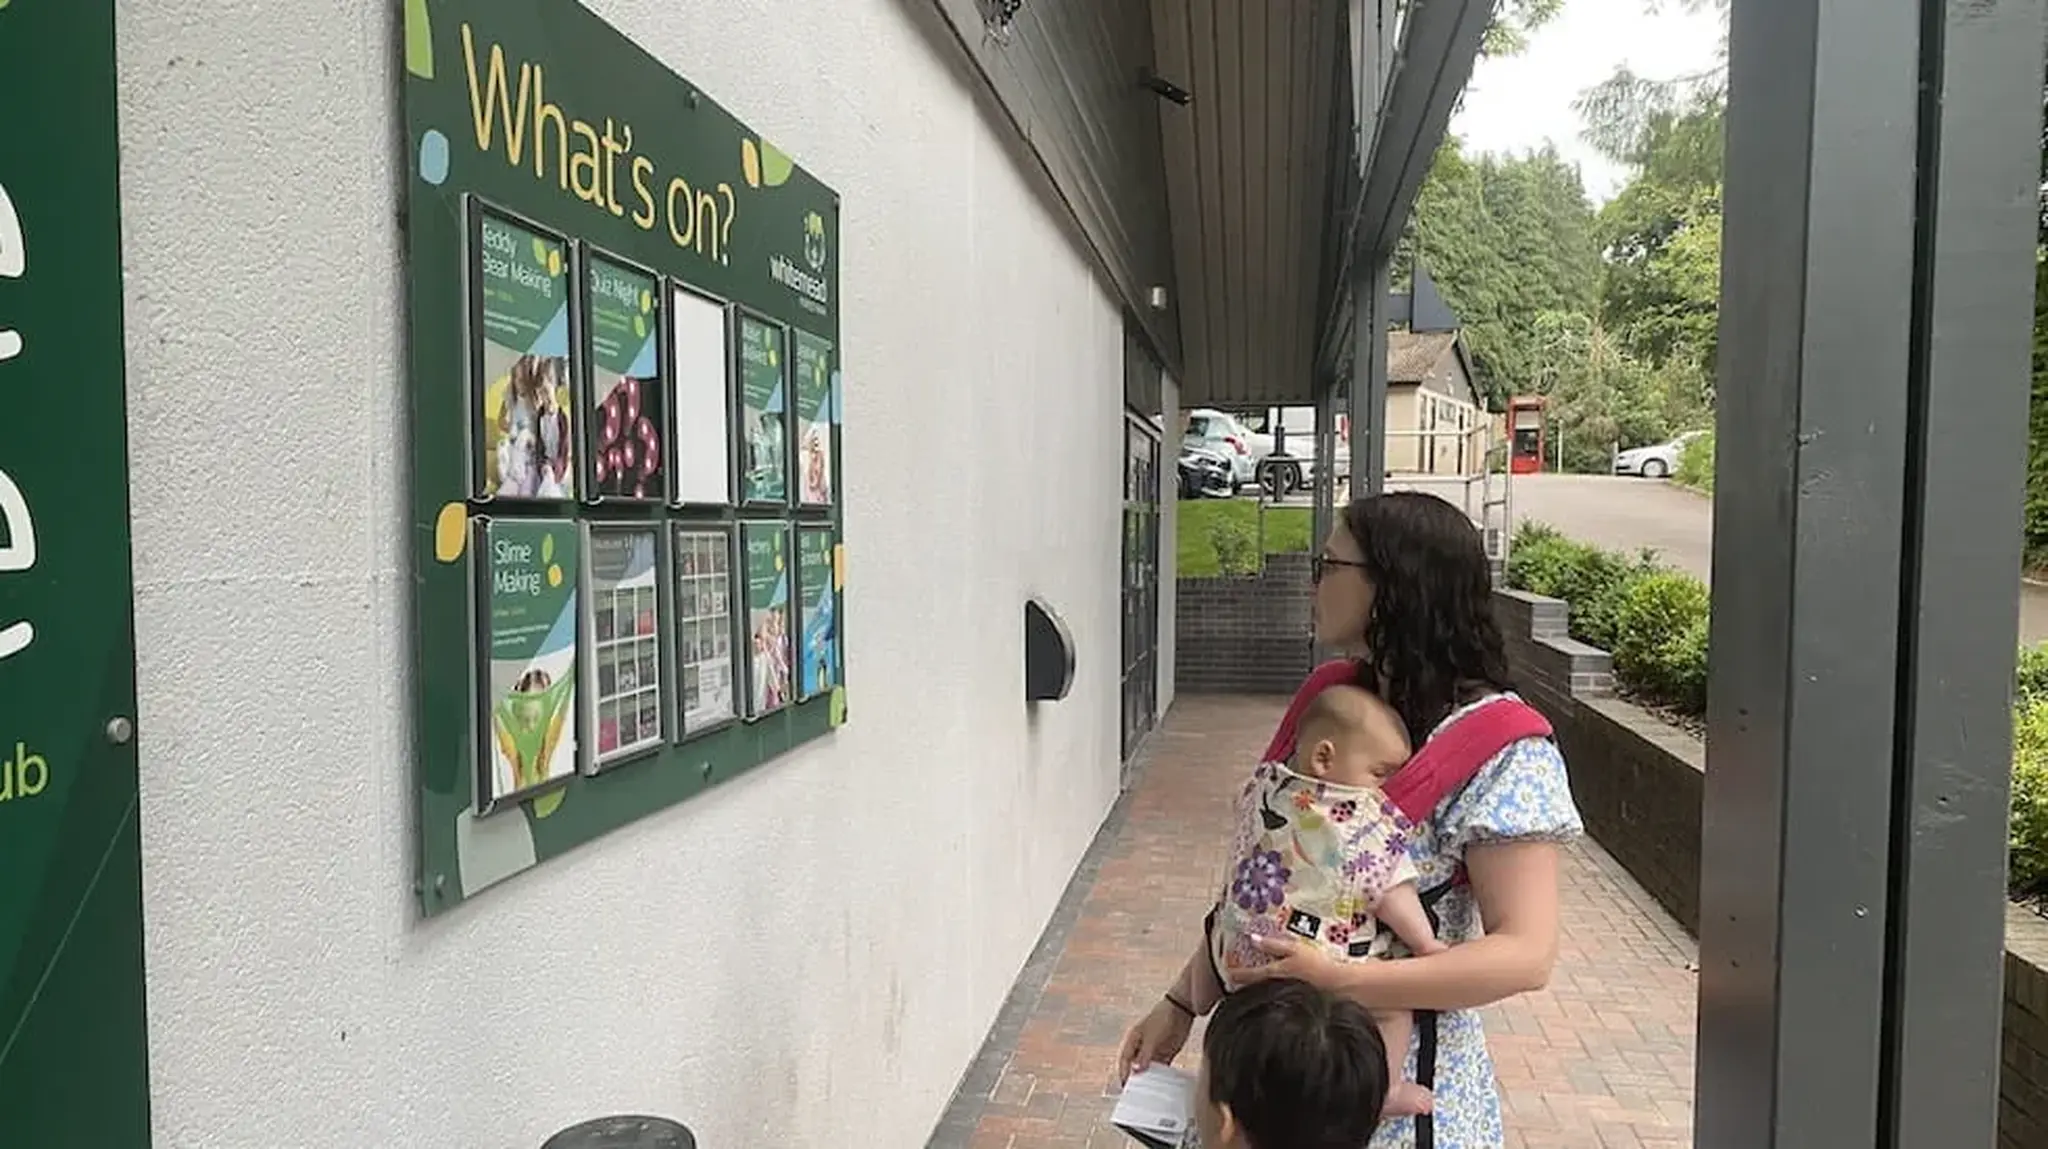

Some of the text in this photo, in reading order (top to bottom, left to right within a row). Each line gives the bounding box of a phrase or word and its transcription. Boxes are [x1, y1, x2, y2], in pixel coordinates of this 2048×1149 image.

[462, 23, 735, 267] What's on?
[510, 260, 552, 299] Making
[494, 539, 532, 564] Slime
[493, 569, 541, 596] Making
